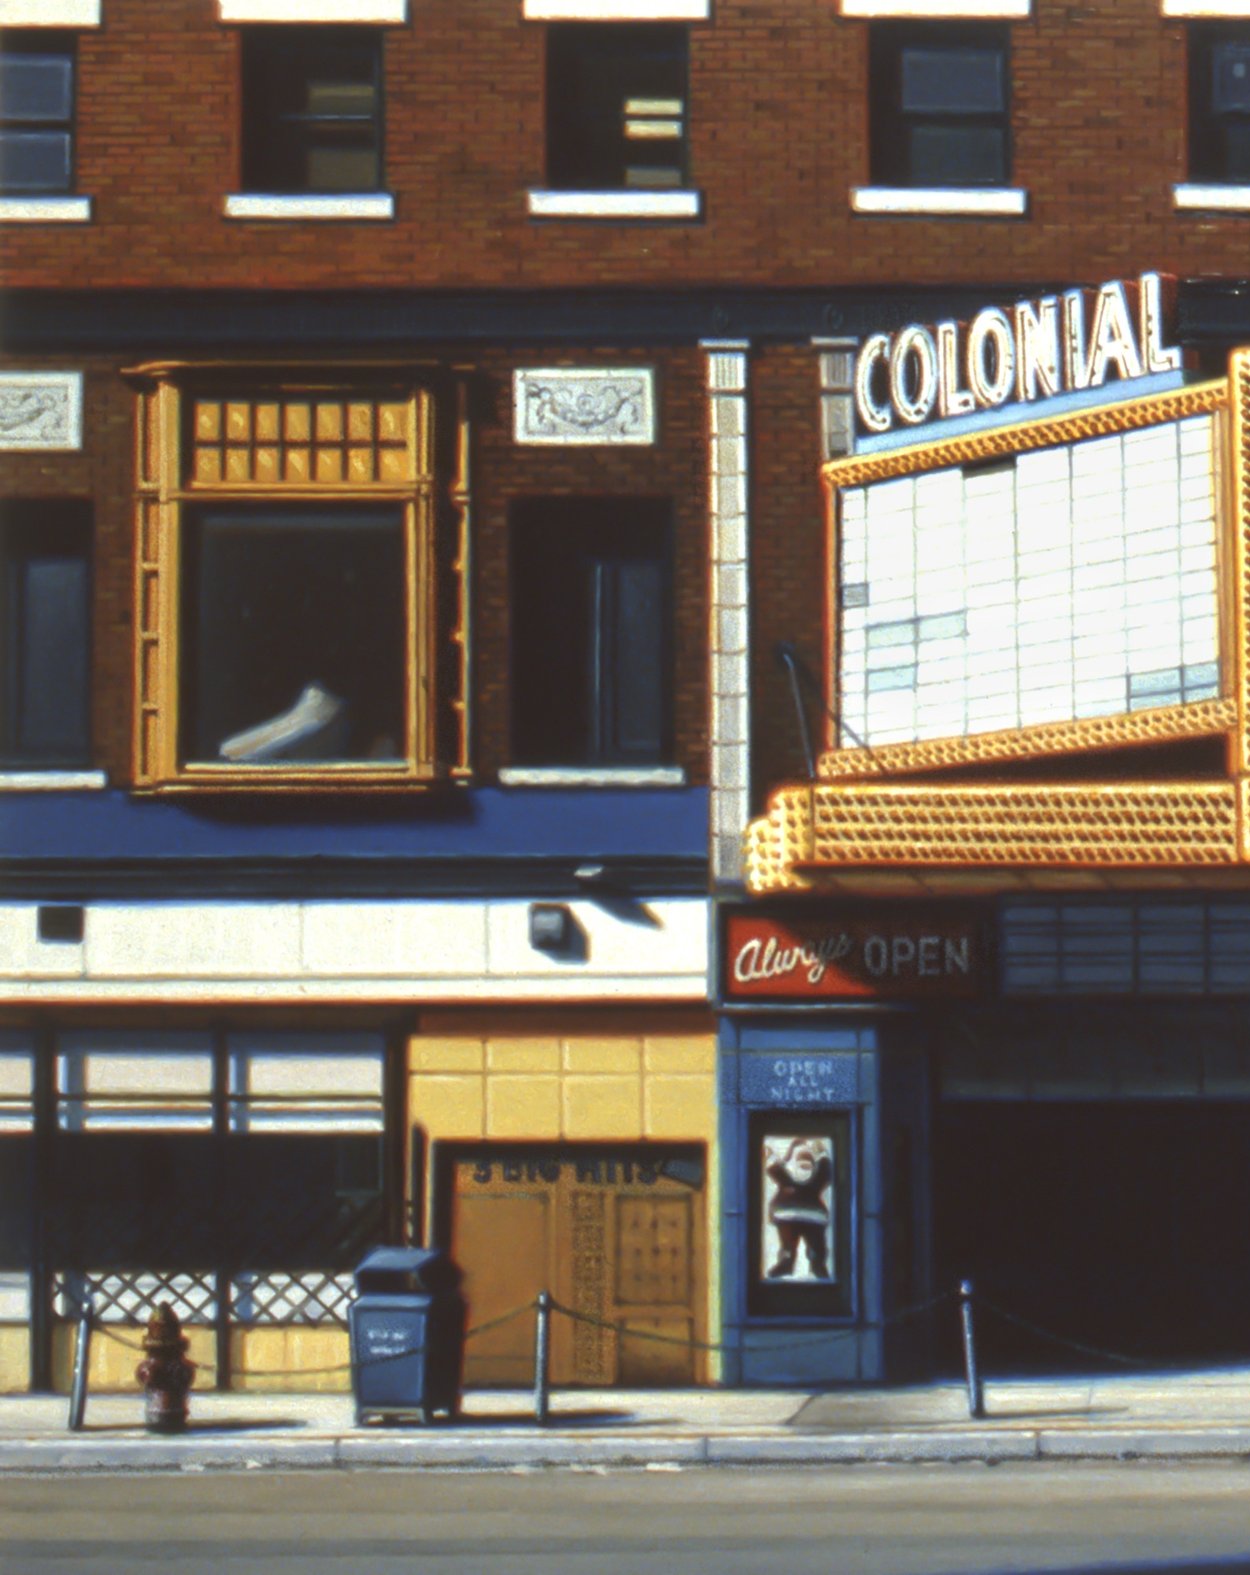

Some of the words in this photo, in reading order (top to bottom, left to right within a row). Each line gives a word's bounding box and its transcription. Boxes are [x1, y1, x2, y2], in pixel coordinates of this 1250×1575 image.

[855, 269, 1183, 432] COLONIAL
[733, 932, 850, 984] Always
[863, 934, 969, 977] OPEN
[773, 1059, 833, 1077] OPEN
[787, 1076, 819, 1088] ALL
[770, 1087, 836, 1102] NIGHT
